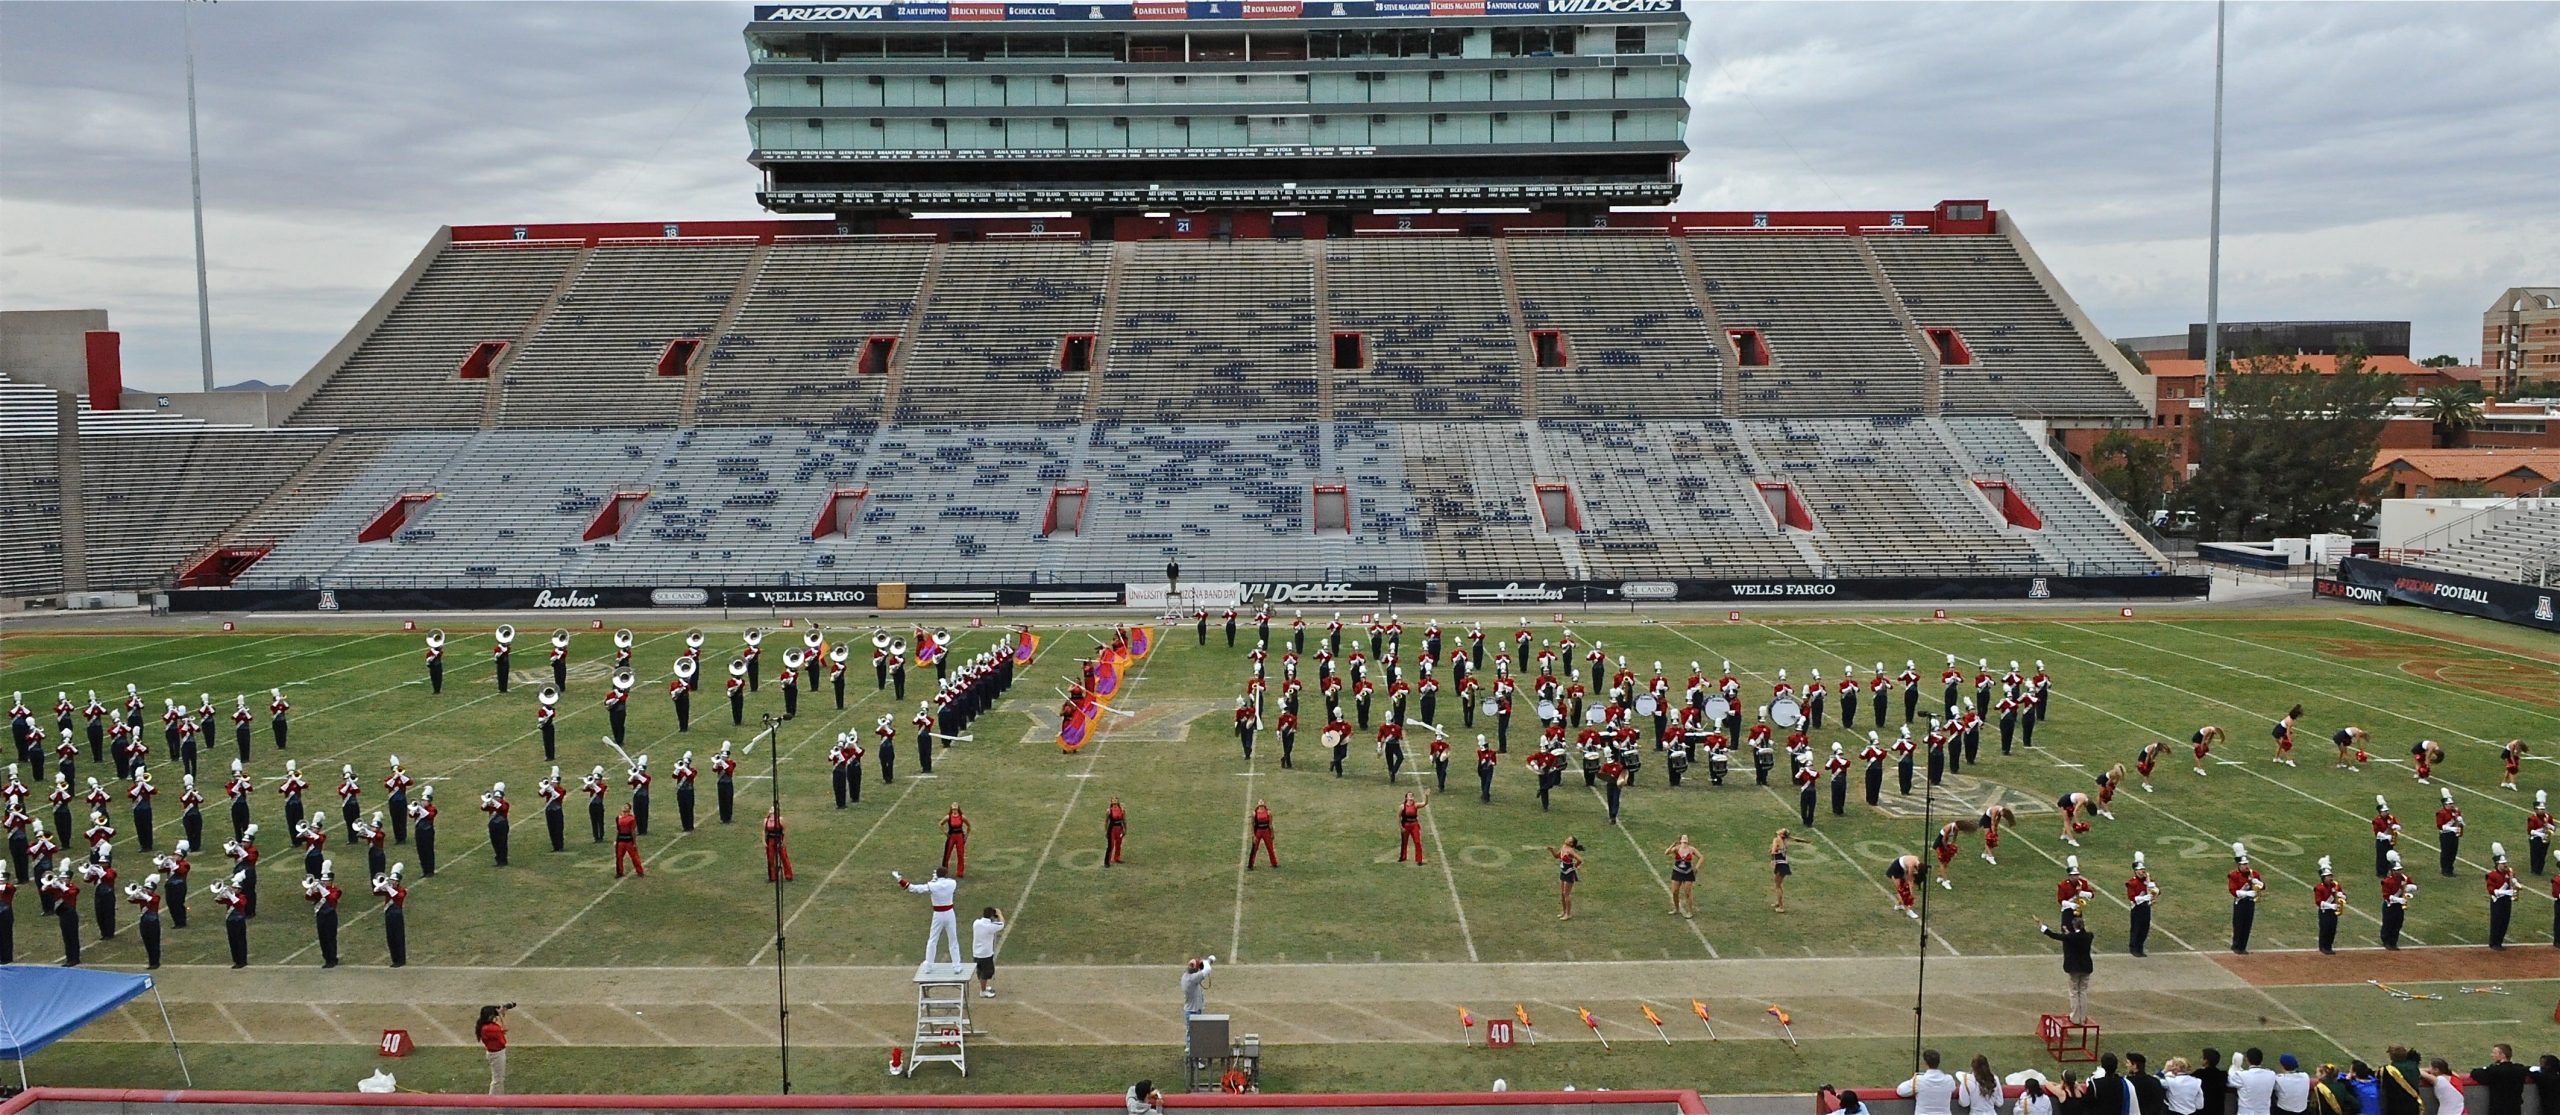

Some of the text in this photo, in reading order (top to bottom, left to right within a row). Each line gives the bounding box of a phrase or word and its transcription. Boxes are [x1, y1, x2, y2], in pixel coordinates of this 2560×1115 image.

[1548, 0, 1674, 12] WILDCATS
[768, 7, 882, 20] ARIZONA
[1178, 222, 1188, 231] 21
[1399, 221, 1411, 230] 22
[1594, 219, 1607, 228] 23
[1754, 218, 1767, 227] 24
[1891, 218, 1904, 226] 25
[837, 226, 848, 235] 19
[1031, 224, 1044, 233] 20
[515, 232, 525, 240] 17
[665, 229, 676, 239] 18
[158, 397, 169, 406] 16
[1240, 584, 1352, 603] WILDCATS
[1731, 584, 1835, 595] WELLS FARGO
[2318, 582, 2382, 602] BEAR DOWN
[2395, 578, 2488, 604] ARIZONA FOOTBALL
[534, 590, 598, 607] Bashas'
[761, 591, 865, 602] WELLS FARGO
[1129, 590, 1163, 600] UNIVERSITY
[1205, 590, 1223, 599] BAND
[1224, 590, 1236, 598] DAY
[1491, 1024, 1509, 1043] 40
[382, 1033, 400, 1053] 40
